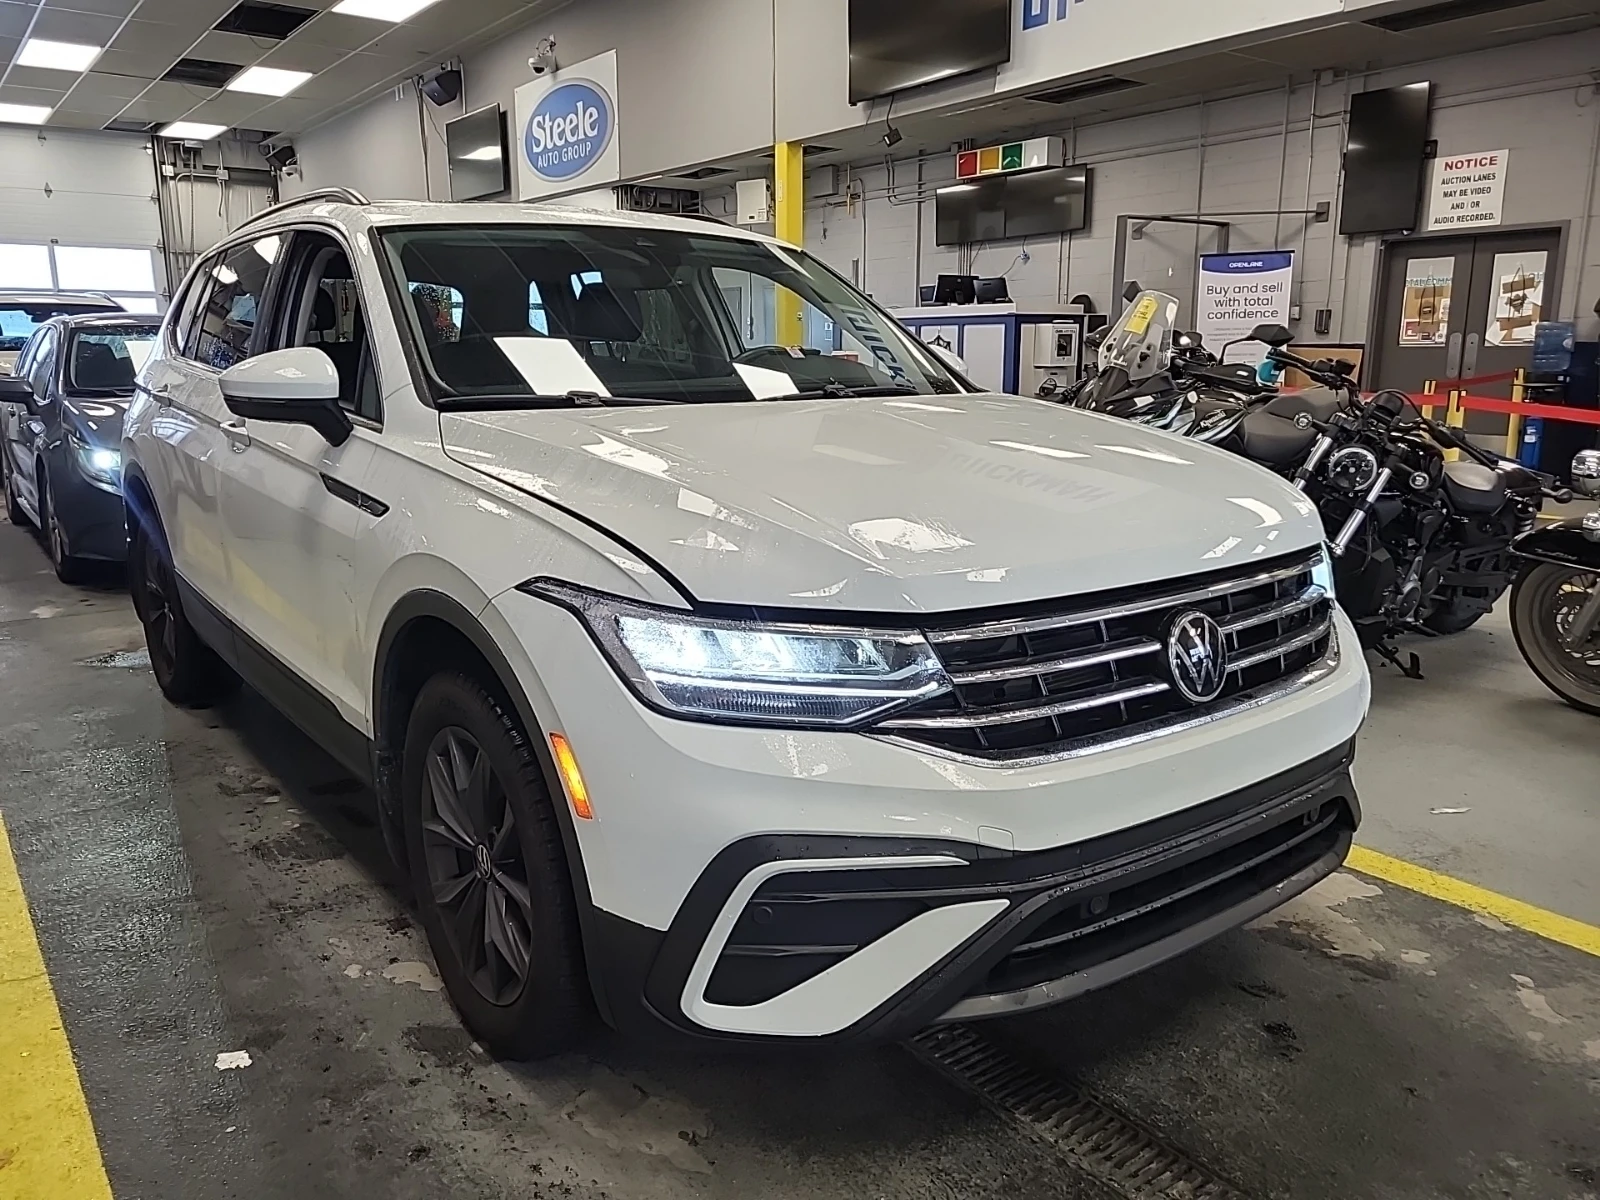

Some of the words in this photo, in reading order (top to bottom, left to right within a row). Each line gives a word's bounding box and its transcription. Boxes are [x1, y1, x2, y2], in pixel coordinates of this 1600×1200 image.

[531, 101, 599, 153] Steele
[538, 151, 559, 169] AUTO
[562, 141, 592, 162] GROUP
[1444, 155, 1499, 171] NOTICE
[1440, 175, 1472, 186] AUCTION
[1473, 172, 1497, 183] LANES
[1442, 190, 1458, 199] MAY
[1459, 188, 1469, 197] BE
[1470, 186, 1492, 196] VIDEO
[1450, 202, 1465, 211] AND
[1470, 200, 1481, 209] OR
[1433, 216, 1455, 225] AUDIO
[1456, 212, 1496, 223] RECORDED.
[1228, 261, 1264, 269] OPENLANE
[1206, 285, 1230, 297] Buy
[1233, 283, 1258, 294] and
[1261, 281, 1283, 293] sell
[1214, 296, 1241, 308] with
[1243, 295, 1273, 306] total
[1207, 308, 1279, 320] confidence
